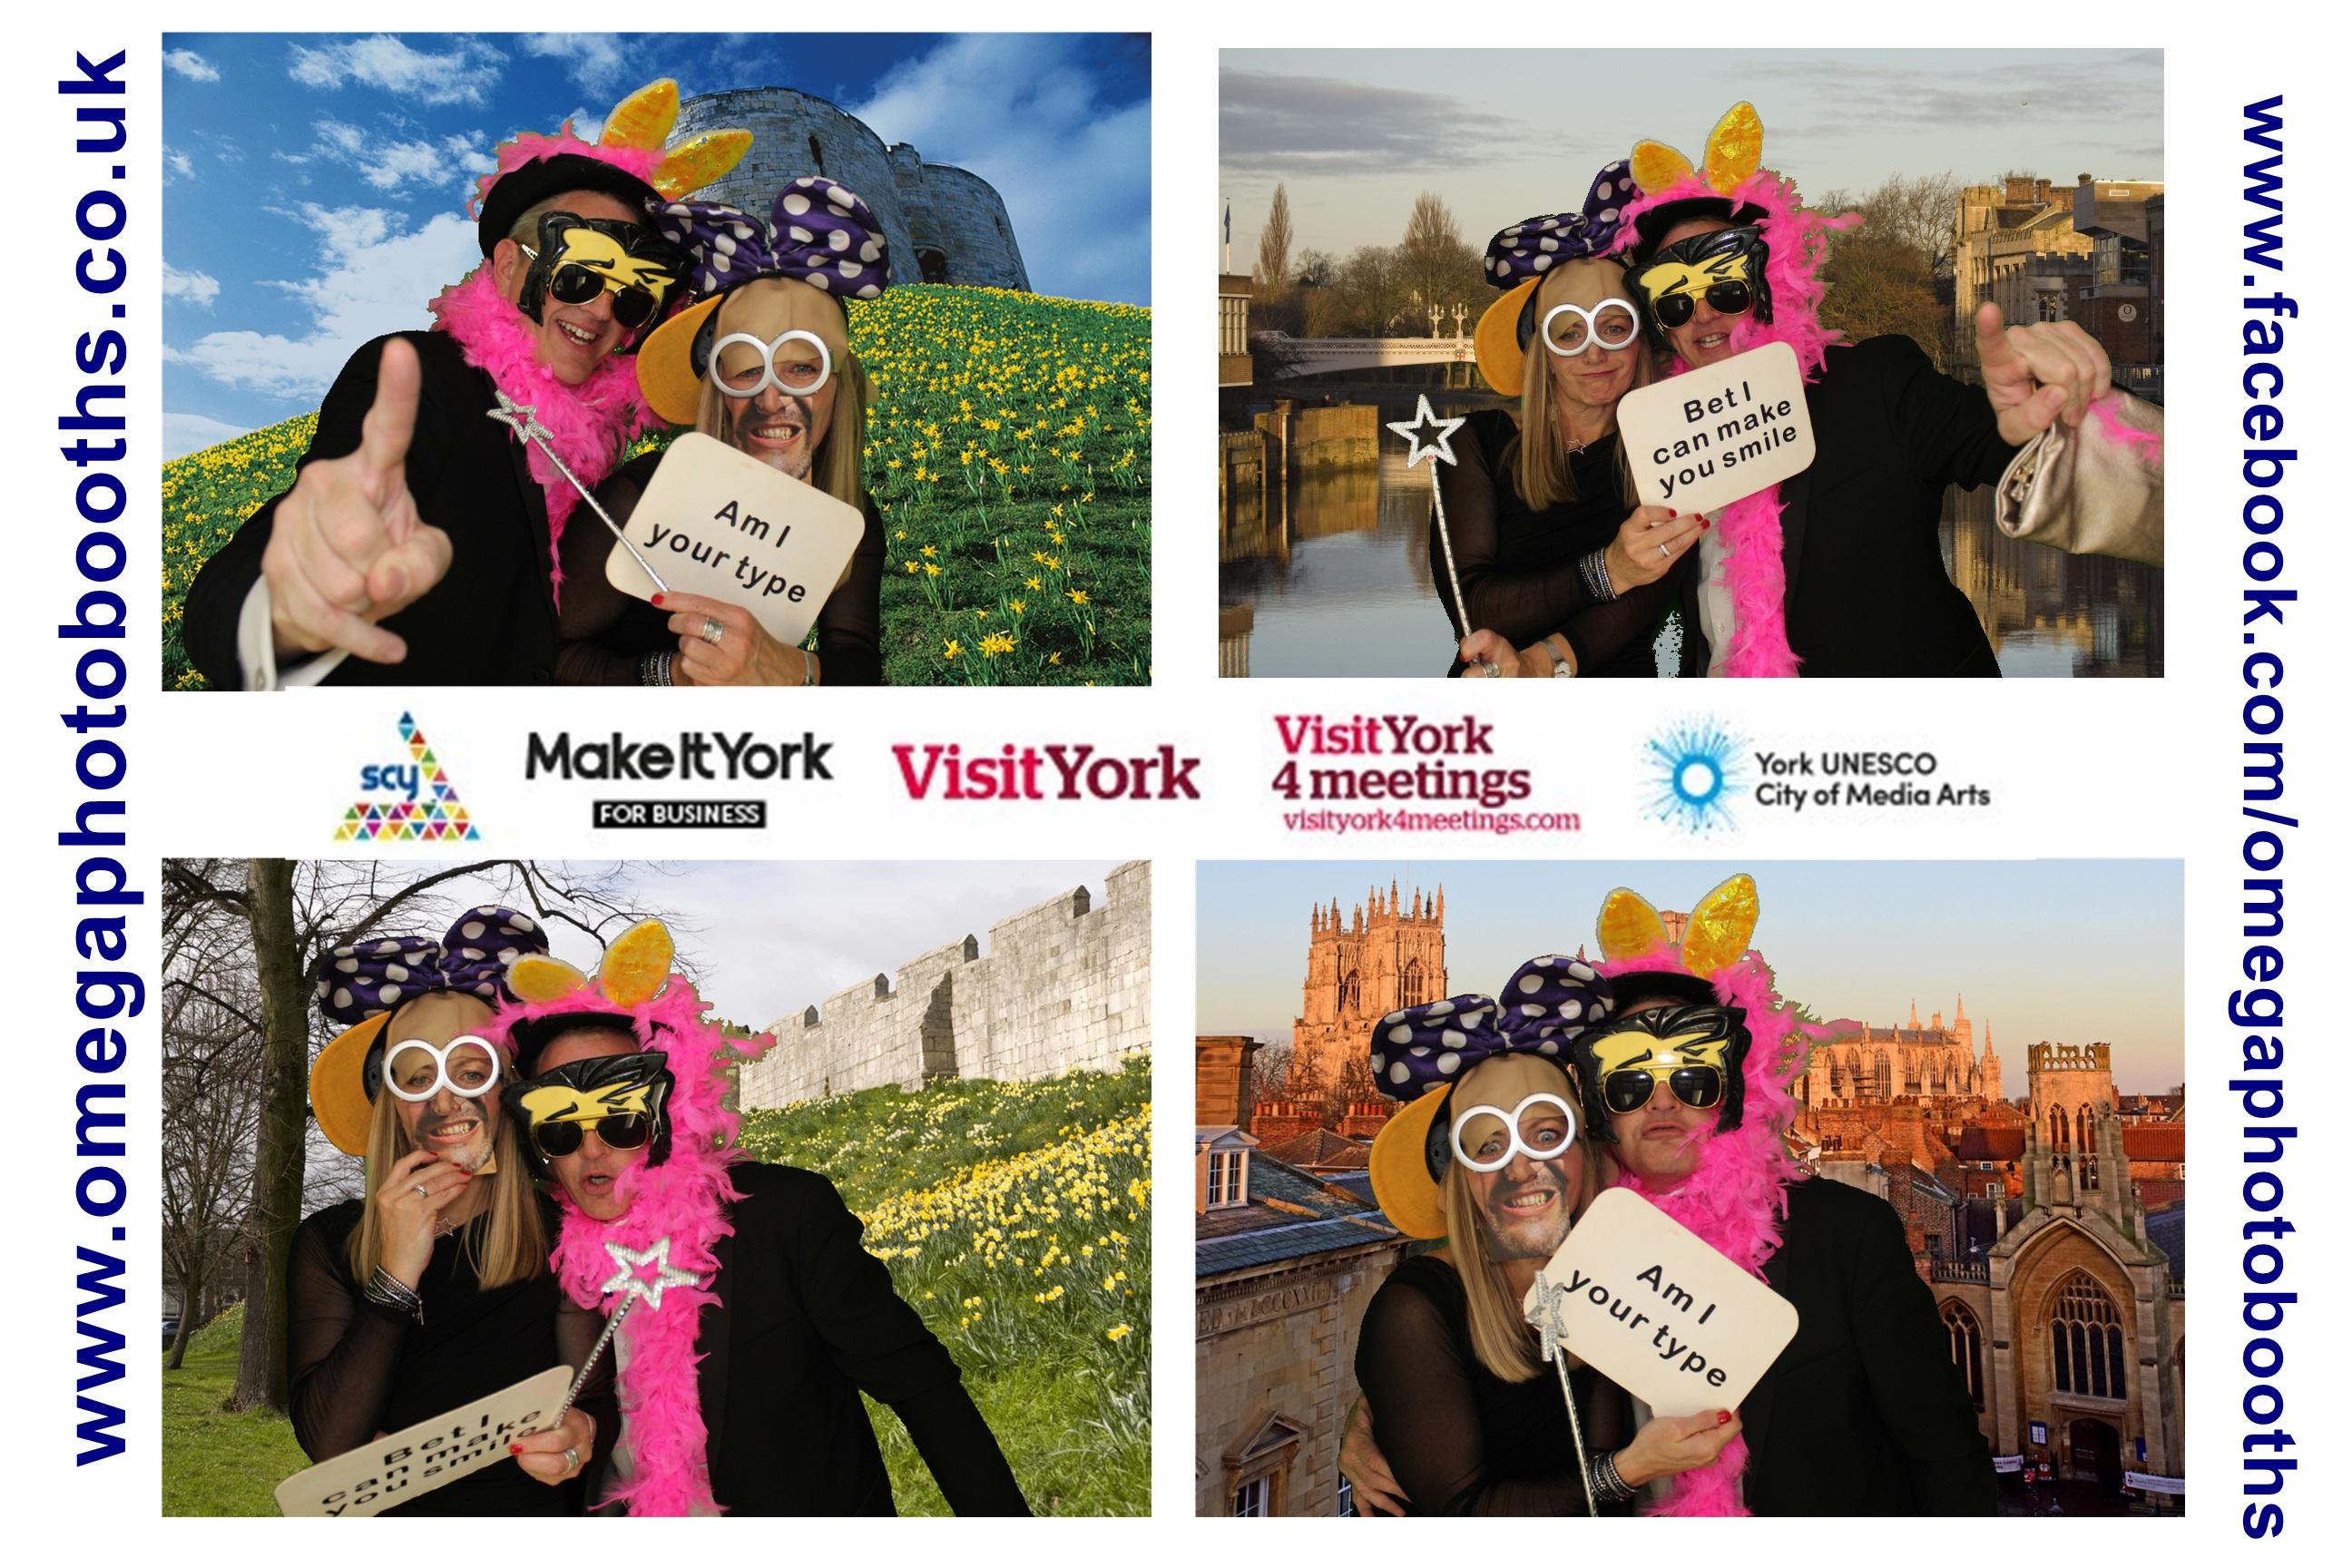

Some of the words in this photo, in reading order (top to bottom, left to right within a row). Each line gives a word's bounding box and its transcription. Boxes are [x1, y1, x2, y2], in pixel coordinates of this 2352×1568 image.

[1652, 432, 1710, 465] can
[1717, 400, 1792, 442] make
[1683, 387, 1739, 424] Bet
[1742, 380, 1751, 402] I
[1659, 459, 1715, 499] you
[1722, 426, 1798, 468] smile
[714, 500, 770, 541] Am
[775, 524, 791, 548] I
[643, 524, 730, 568] your
[735, 555, 807, 603] type
[1563, 1269, 1650, 1329] your
[1652, 1325, 1727, 1387] type
[1636, 1265, 1694, 1312] Am
[1698, 1303, 1716, 1325] I
[321, 1465, 409, 1505] can
[425, 1410, 542, 1464] make
[324, 1478, 408, 1517] you
[423, 1426, 538, 1478] smile
[384, 1426, 466, 1466] Bet
[480, 1414, 490, 1428] I
